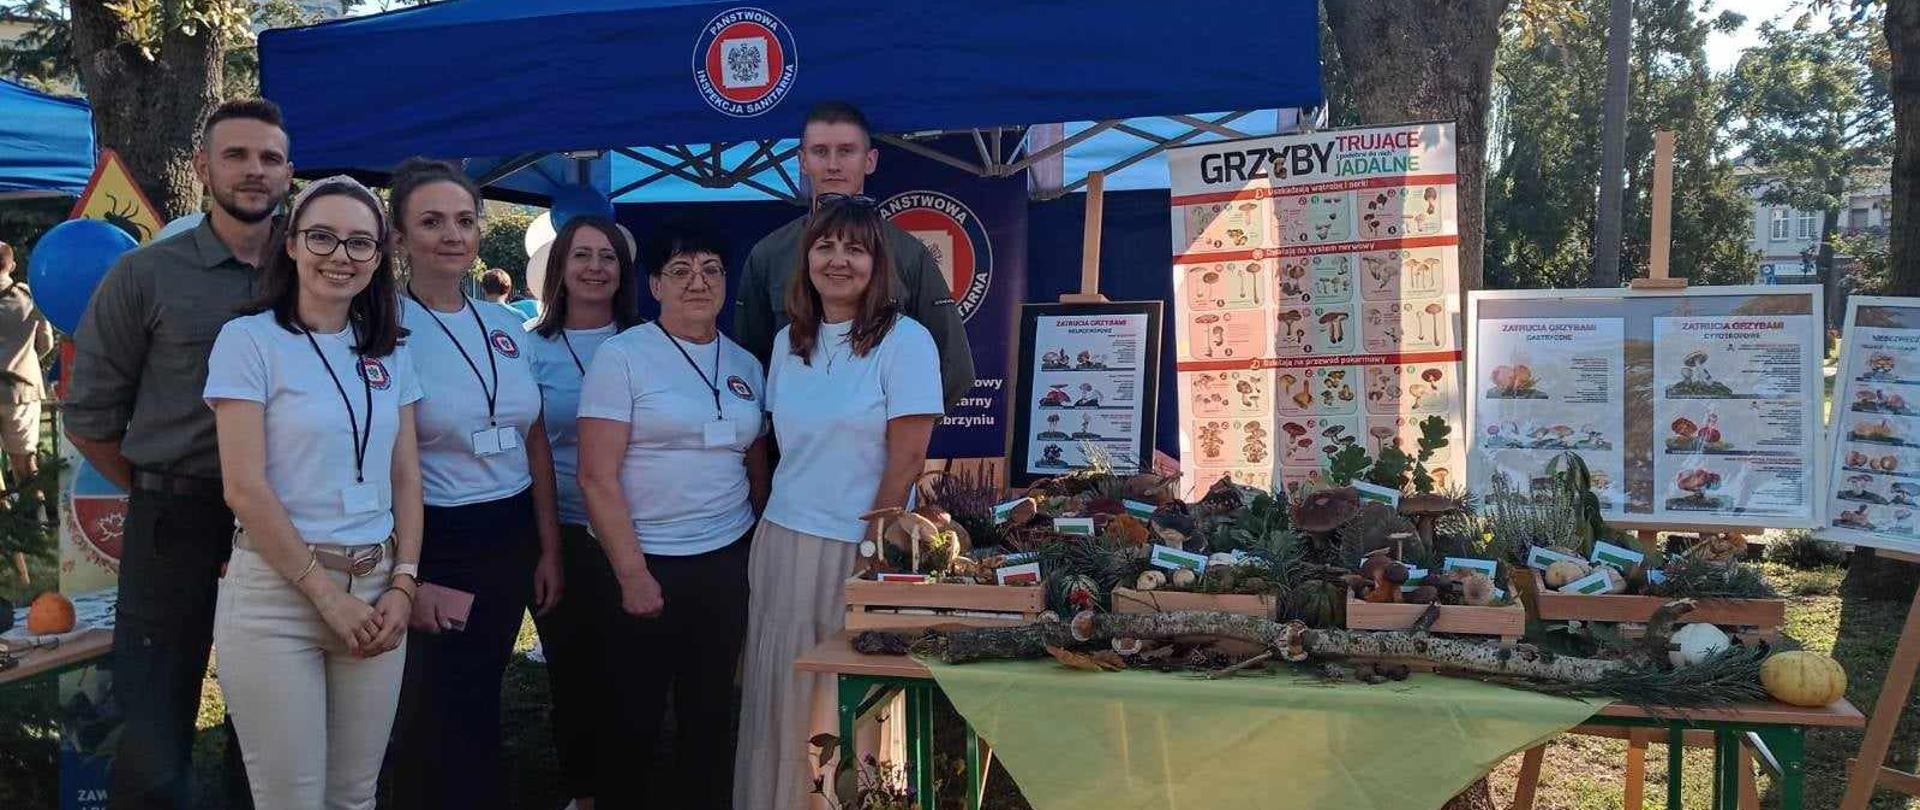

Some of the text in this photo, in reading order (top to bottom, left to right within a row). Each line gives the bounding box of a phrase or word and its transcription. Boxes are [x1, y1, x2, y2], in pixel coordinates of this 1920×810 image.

[697, 64, 794, 113] INSPEKCJA SANITARNA
[1201, 140, 1335, 185] GRZYBY
[1335, 131, 1419, 152] TRUJĄCE
[1334, 155, 1420, 177] JADALNE
[958, 272, 988, 316] TARNA
